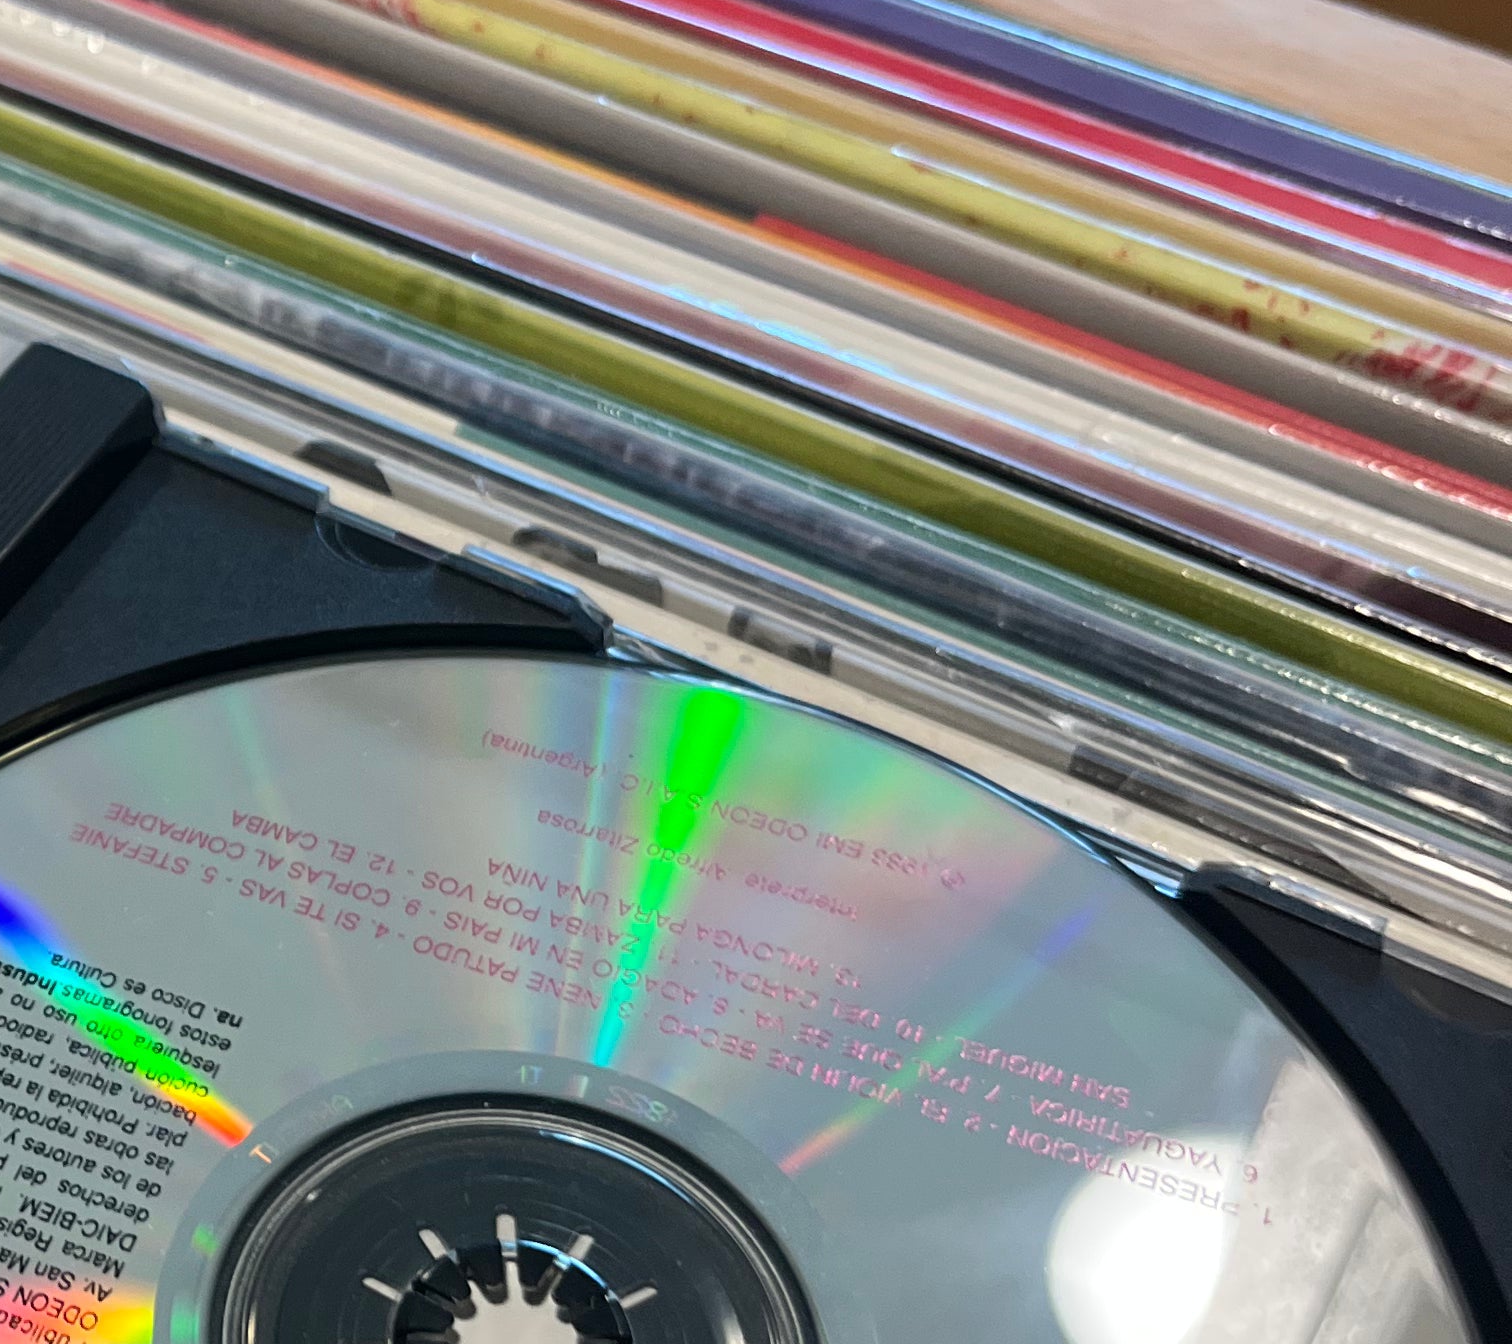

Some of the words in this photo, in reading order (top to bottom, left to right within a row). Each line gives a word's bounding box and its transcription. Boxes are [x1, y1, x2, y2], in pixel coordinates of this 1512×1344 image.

[103, 801, 247, 861] COMPADRE
[231, 808, 319, 851] CAMBA
[536, 808, 640, 855] Zitarrosa
[70, 822, 191, 875] STEFANIE
[254, 847, 284, 871] AL
[326, 838, 356, 864] EL
[286, 860, 391, 907] COPLAS
[420, 869, 474, 902] VOS
[487, 856, 548, 892] NIÑA
[237, 877, 286, 909] VAS
[292, 894, 325, 922] TE
[482, 889, 541, 922] POR
[332, 908, 361, 932] SI
[442, 910, 503, 944] PAIS
[411, 934, 520, 984] PATUDO
[9, 992, 36, 1011] no
[122, 977, 146, 995] es
[42, 1003, 78, 1026] uso
[150, 987, 206, 1019] Disco
[212, 1006, 243, 1028] na.
[84, 1019, 123, 1040] otro
[178, 1023, 232, 1051] estos
[65, 1035, 138, 1074] pública,
[132, 1034, 220, 1079] lesquiera
[24, 1079, 44, 1101] la
[48, 1057, 123, 1096] alquiler,
[144, 1068, 209, 1097] cución
[46, 1087, 139, 1135] Prohibida
[128, 1084, 197, 1126] bación,
[2, 1126, 20, 1145] y
[82, 1129, 139, 1159] obras
[144, 1121, 188, 1147] plar.
[20, 1136, 97, 1173] autores
[143, 1150, 174, 1176] las
[12, 1163, 47, 1186] del
[99, 1164, 132, 1190] los
[134, 1177, 162, 1198] de
[56, 1178, 150, 1224] derechos
[18, 1192, 138, 1253] DAIC-BIEM.
[60, 1238, 125, 1279] Marca
[33, 1260, 76, 1291] San
[82, 1280, 113, 1302] Av.
[11, 1284, 99, 1331] ODEON
